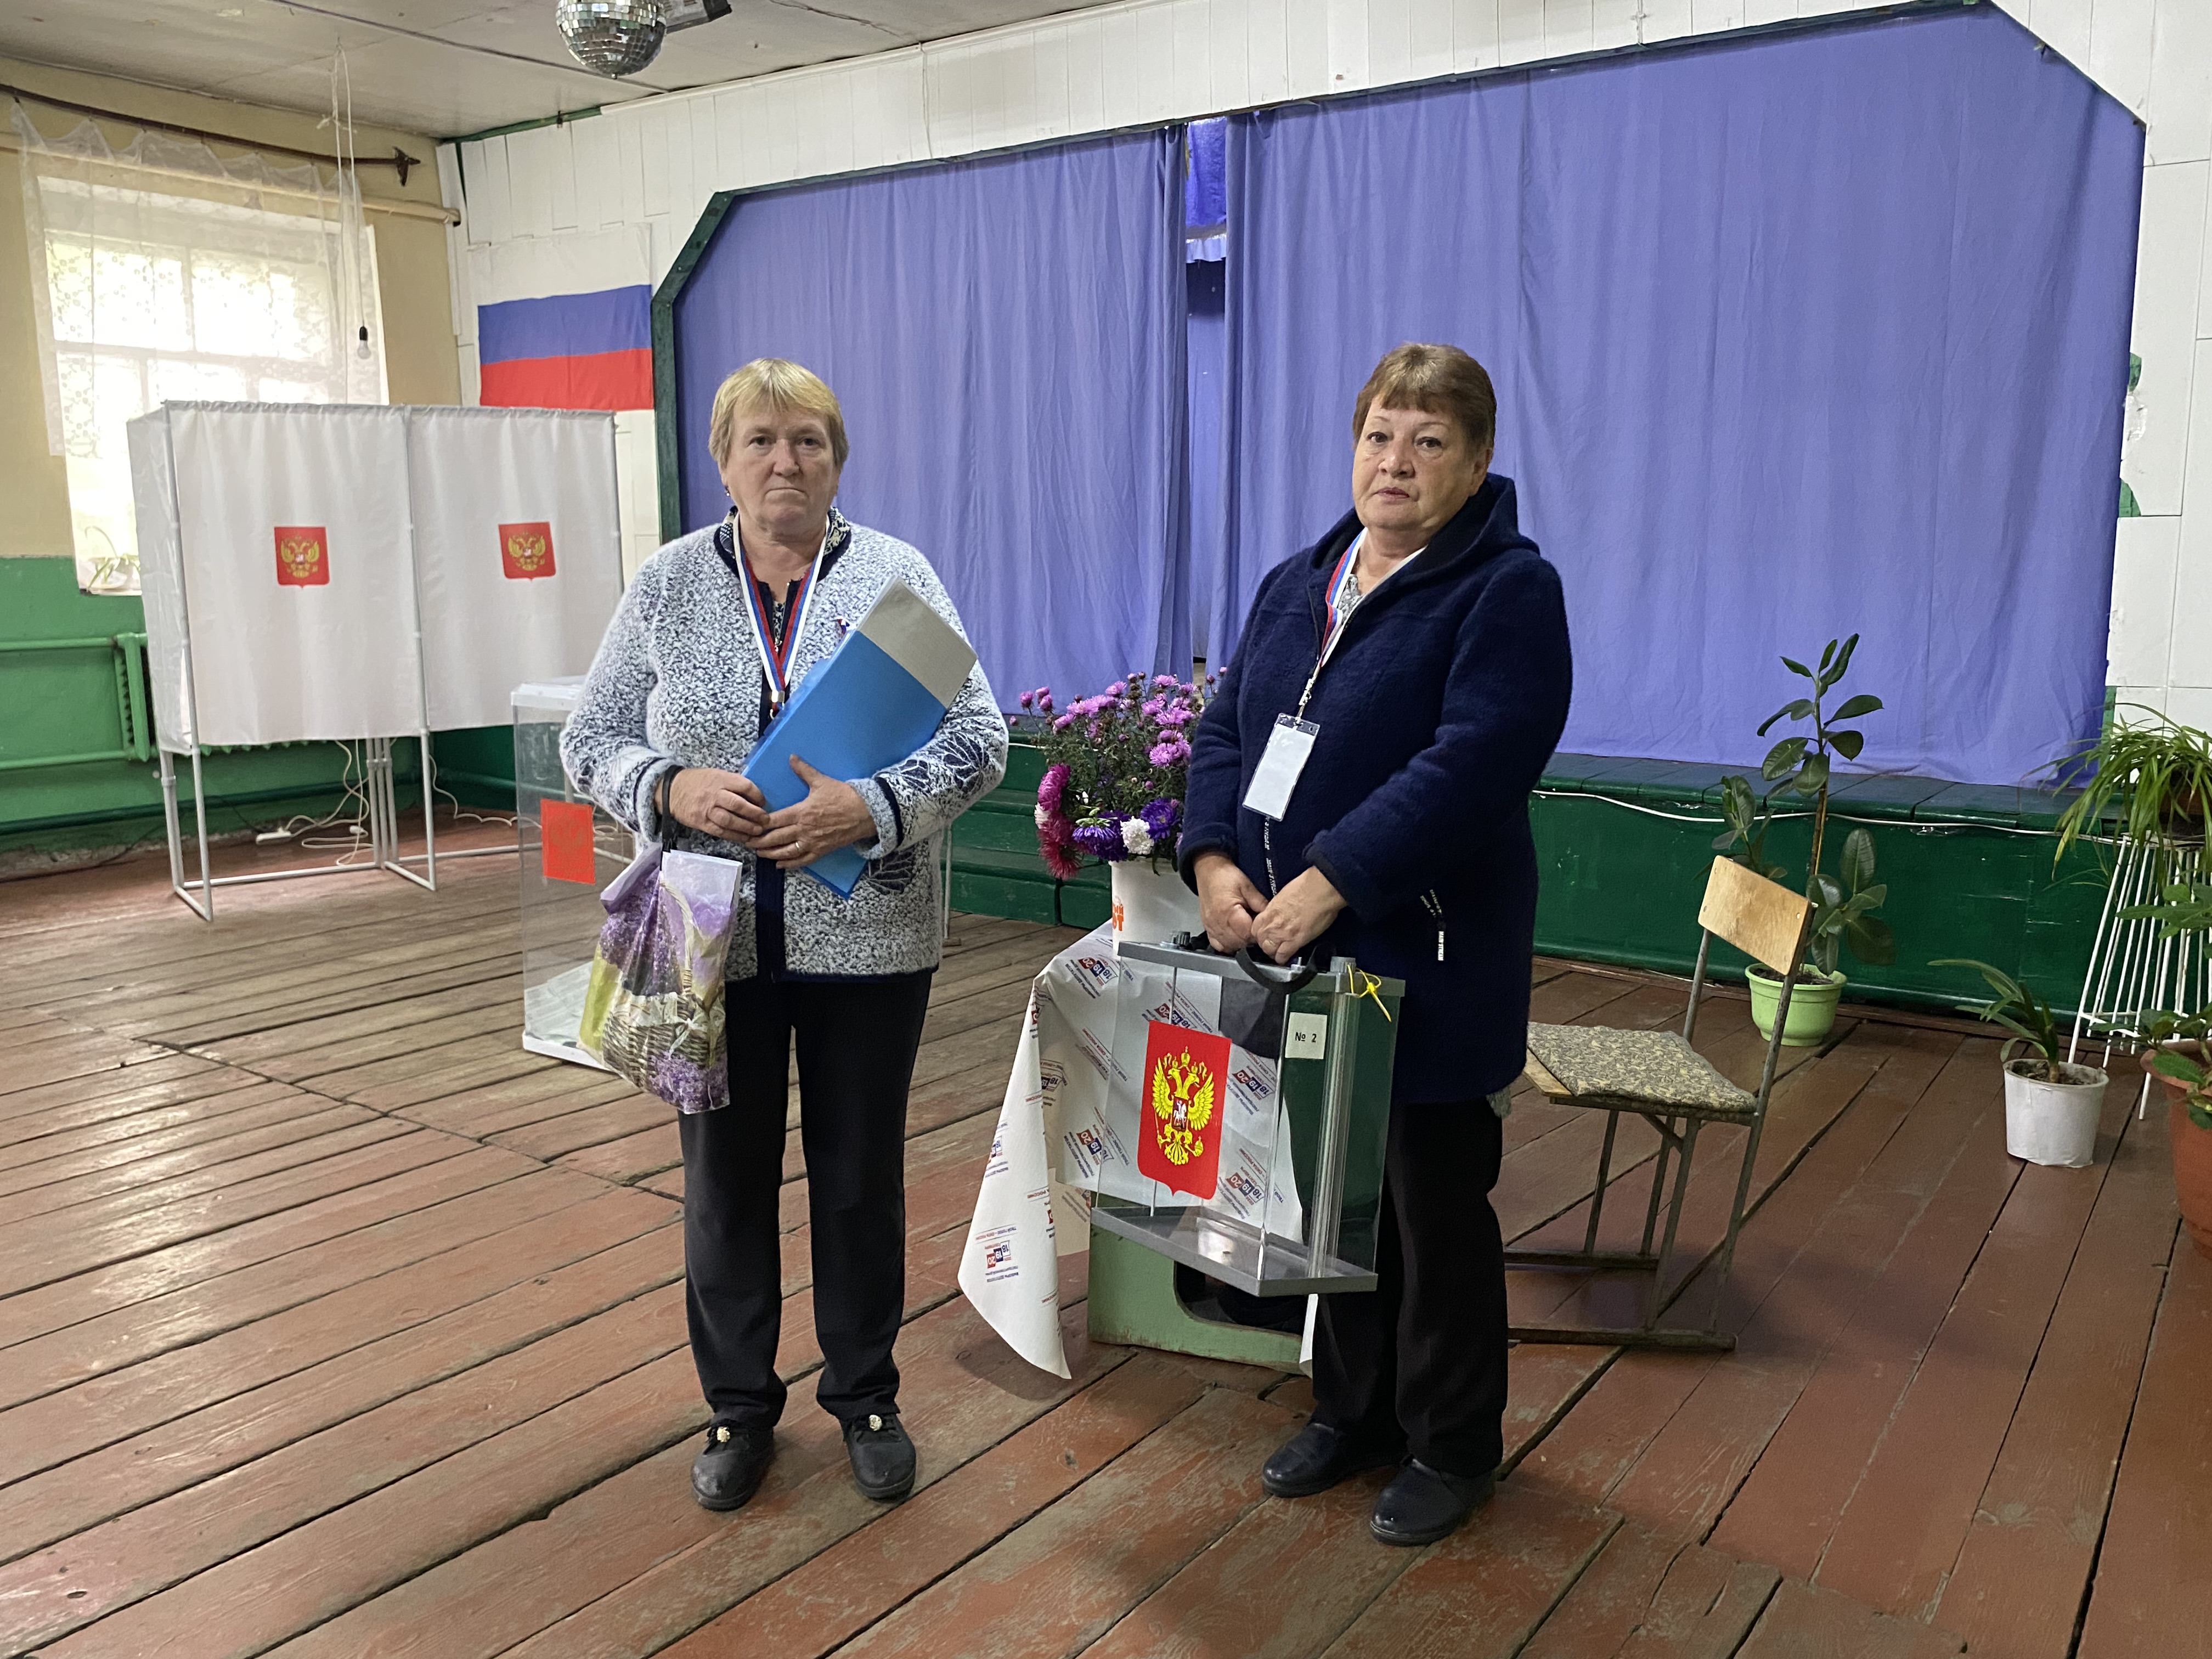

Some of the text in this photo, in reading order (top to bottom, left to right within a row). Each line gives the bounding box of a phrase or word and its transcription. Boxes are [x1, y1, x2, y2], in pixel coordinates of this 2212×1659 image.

[1083, 957, 1093, 967] 20
[1093, 964, 1102, 973] 19
[1103, 969, 1112, 979] 18
[1159, 1006, 1169, 1015] 20
[1295, 1032, 1317, 1043] № 2
[1238, 1071, 1248, 1083] 20
[1249, 1080, 1258, 1089] 19
[1260, 1086, 1269, 1094] 18
[1080, 1131, 1092, 1143] 20
[1091, 1142, 1100, 1152] 19
[1231, 1176, 1262, 1199] 18 19 20
[1002, 1244, 1009, 1252] 18
[996, 1250, 1002, 1259] 19
